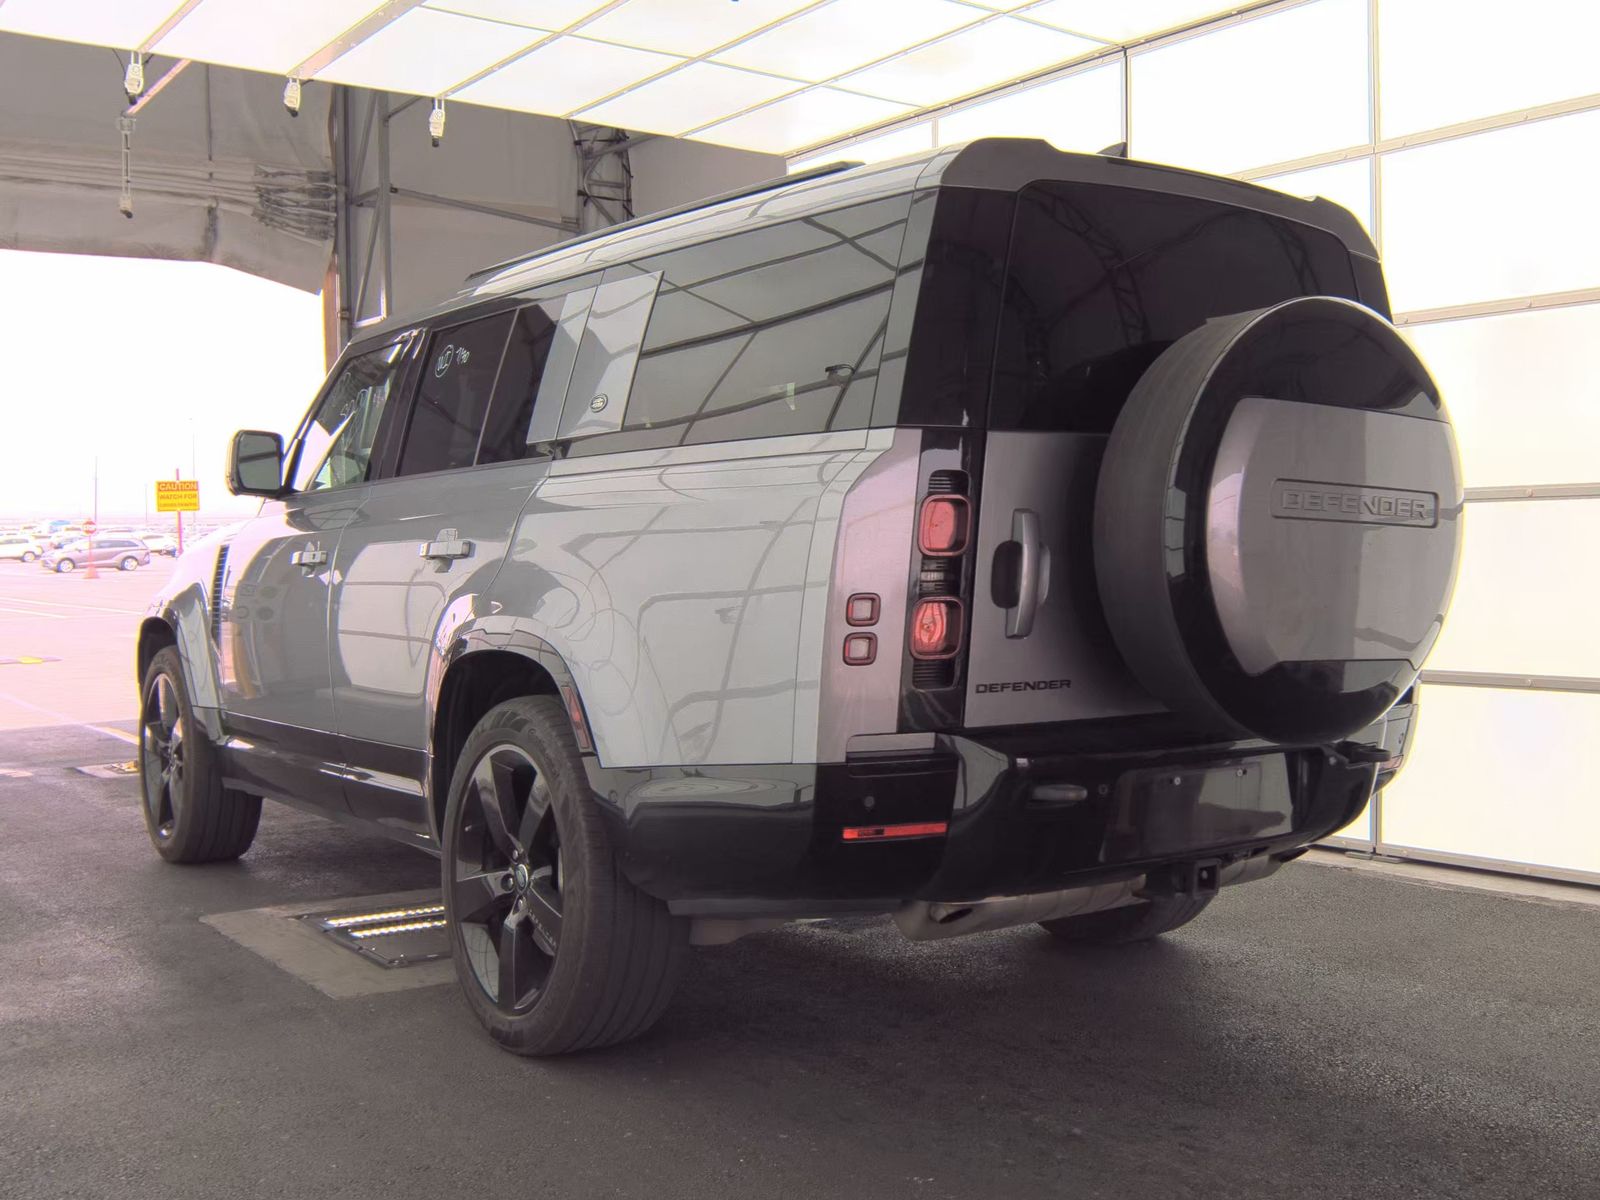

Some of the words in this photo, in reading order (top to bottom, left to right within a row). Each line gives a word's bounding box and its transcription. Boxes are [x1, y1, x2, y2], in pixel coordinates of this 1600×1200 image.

[159, 482, 197, 491] CAUTION
[1282, 489, 1426, 520] DEFENDER
[975, 679, 1072, 694] DEFENDER
